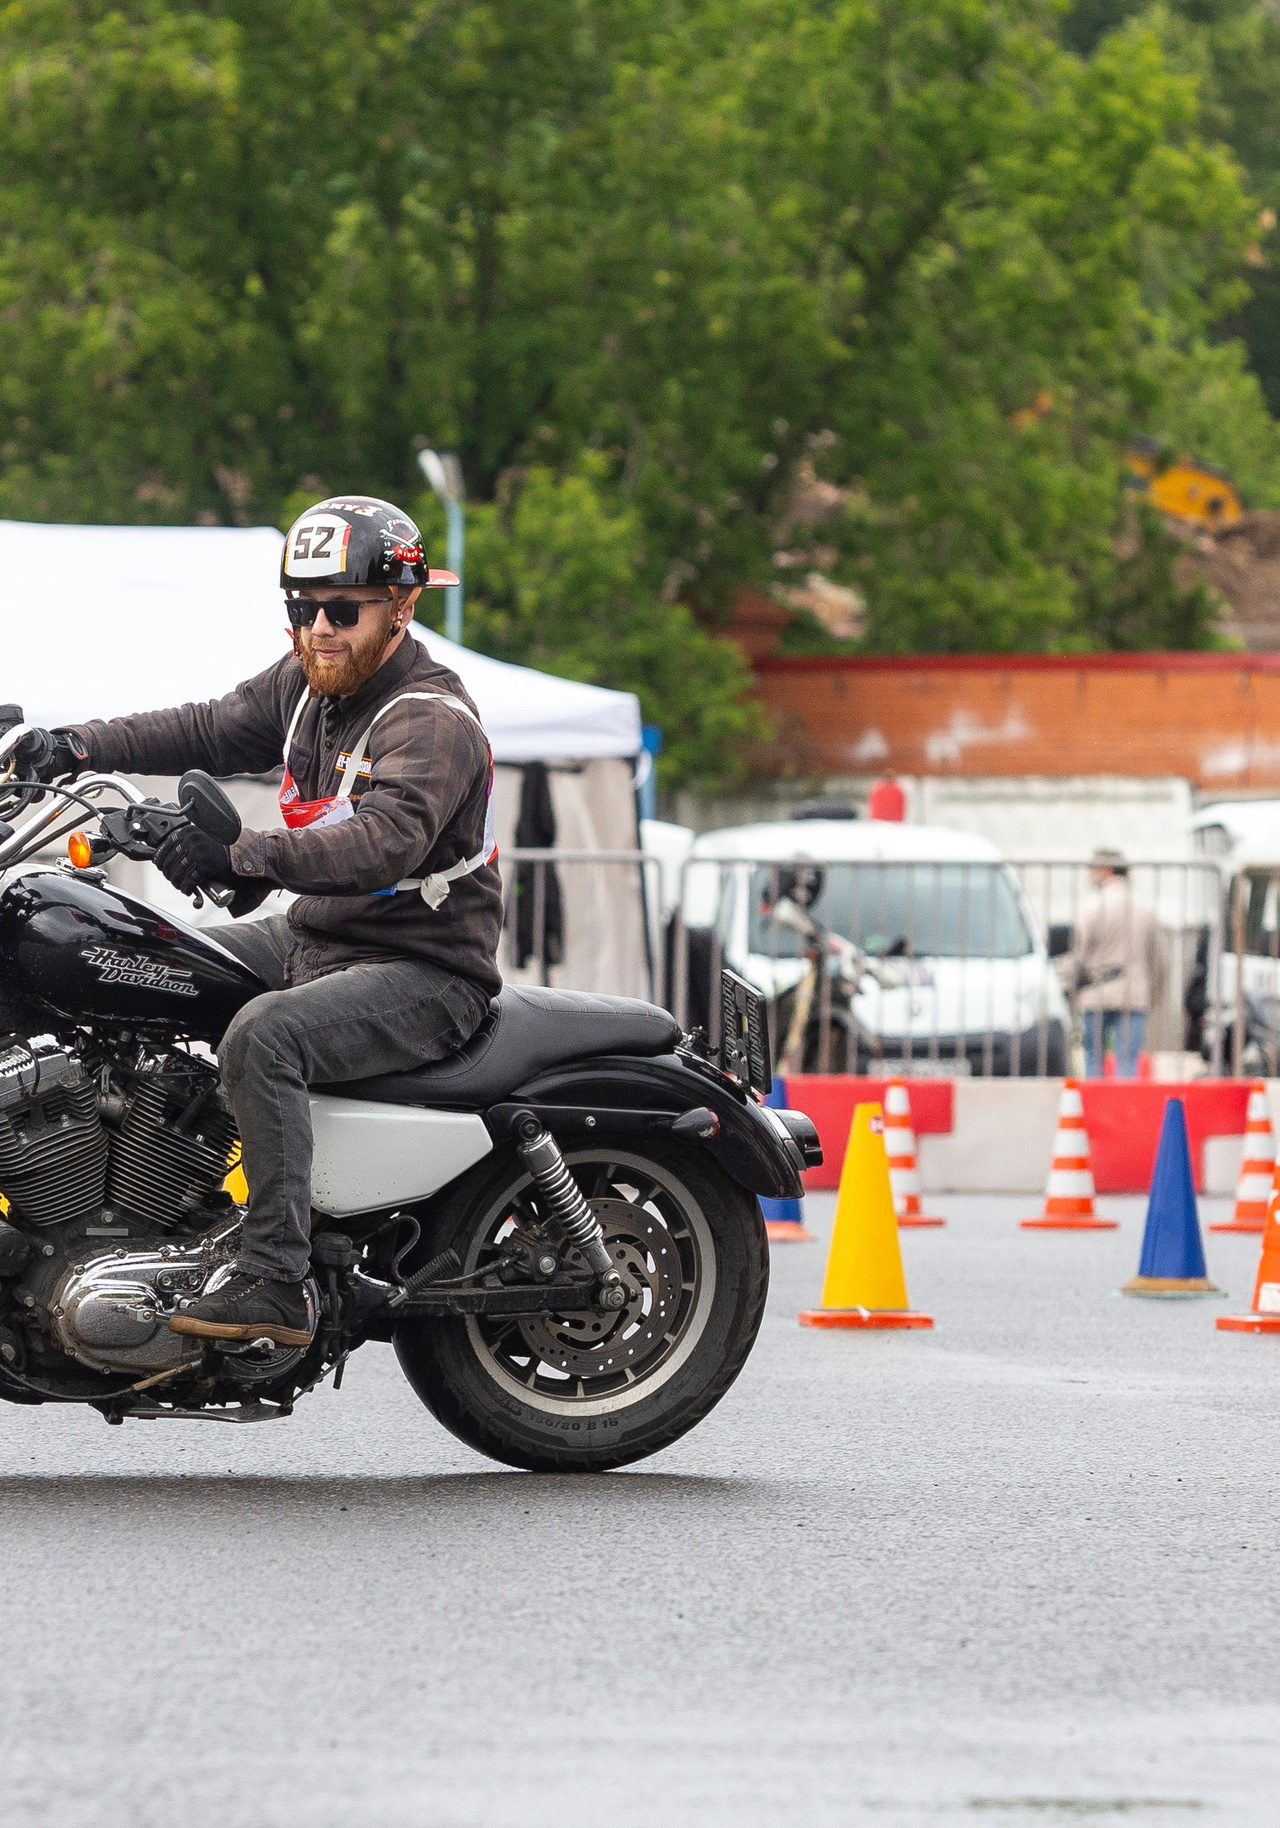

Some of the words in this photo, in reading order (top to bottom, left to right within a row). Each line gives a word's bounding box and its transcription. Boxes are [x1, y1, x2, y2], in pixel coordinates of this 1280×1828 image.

[293, 526, 336, 560] 52
[81, 946, 192, 979] Harley
[98, 965, 199, 996] Davidson
